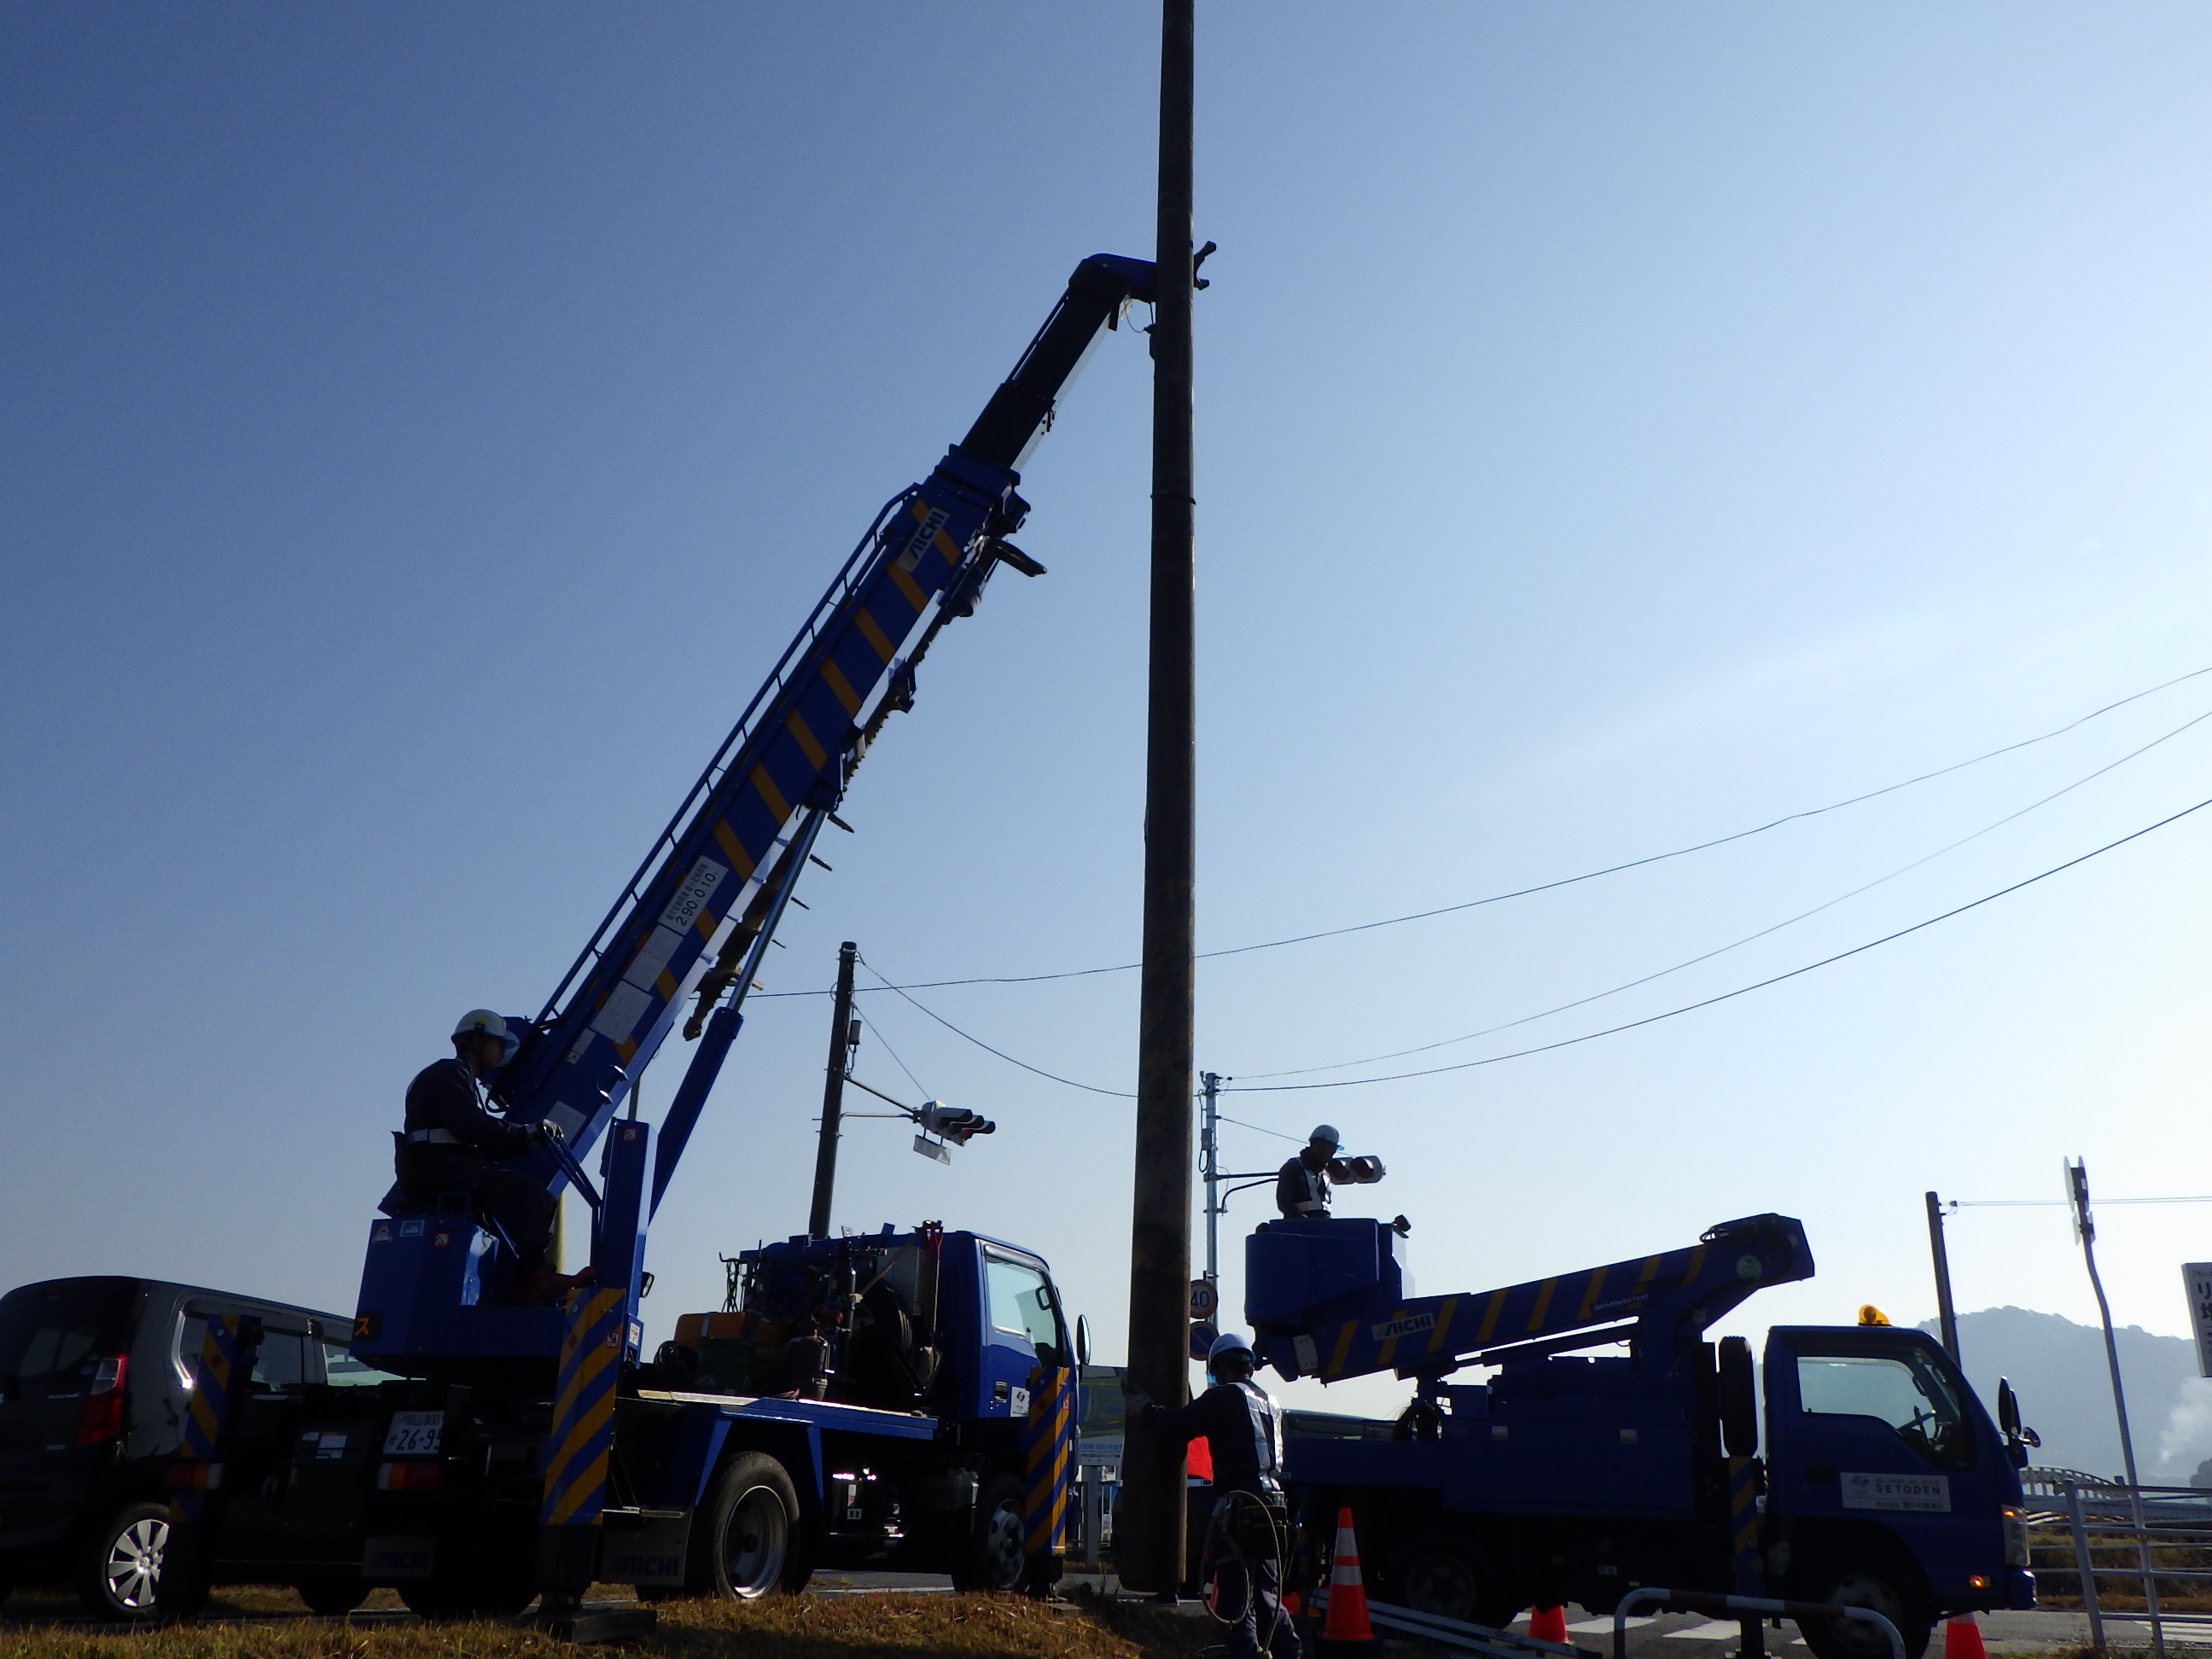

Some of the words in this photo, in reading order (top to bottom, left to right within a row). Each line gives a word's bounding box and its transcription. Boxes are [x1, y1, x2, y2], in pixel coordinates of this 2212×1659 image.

[907, 510, 945, 561] AICHI
[1190, 1290, 1210, 1307] 40
[1384, 1315, 1432, 1336] AICHI
[1876, 1484, 1941, 1495] SETODEN
[616, 1557, 679, 1577] AICHI
